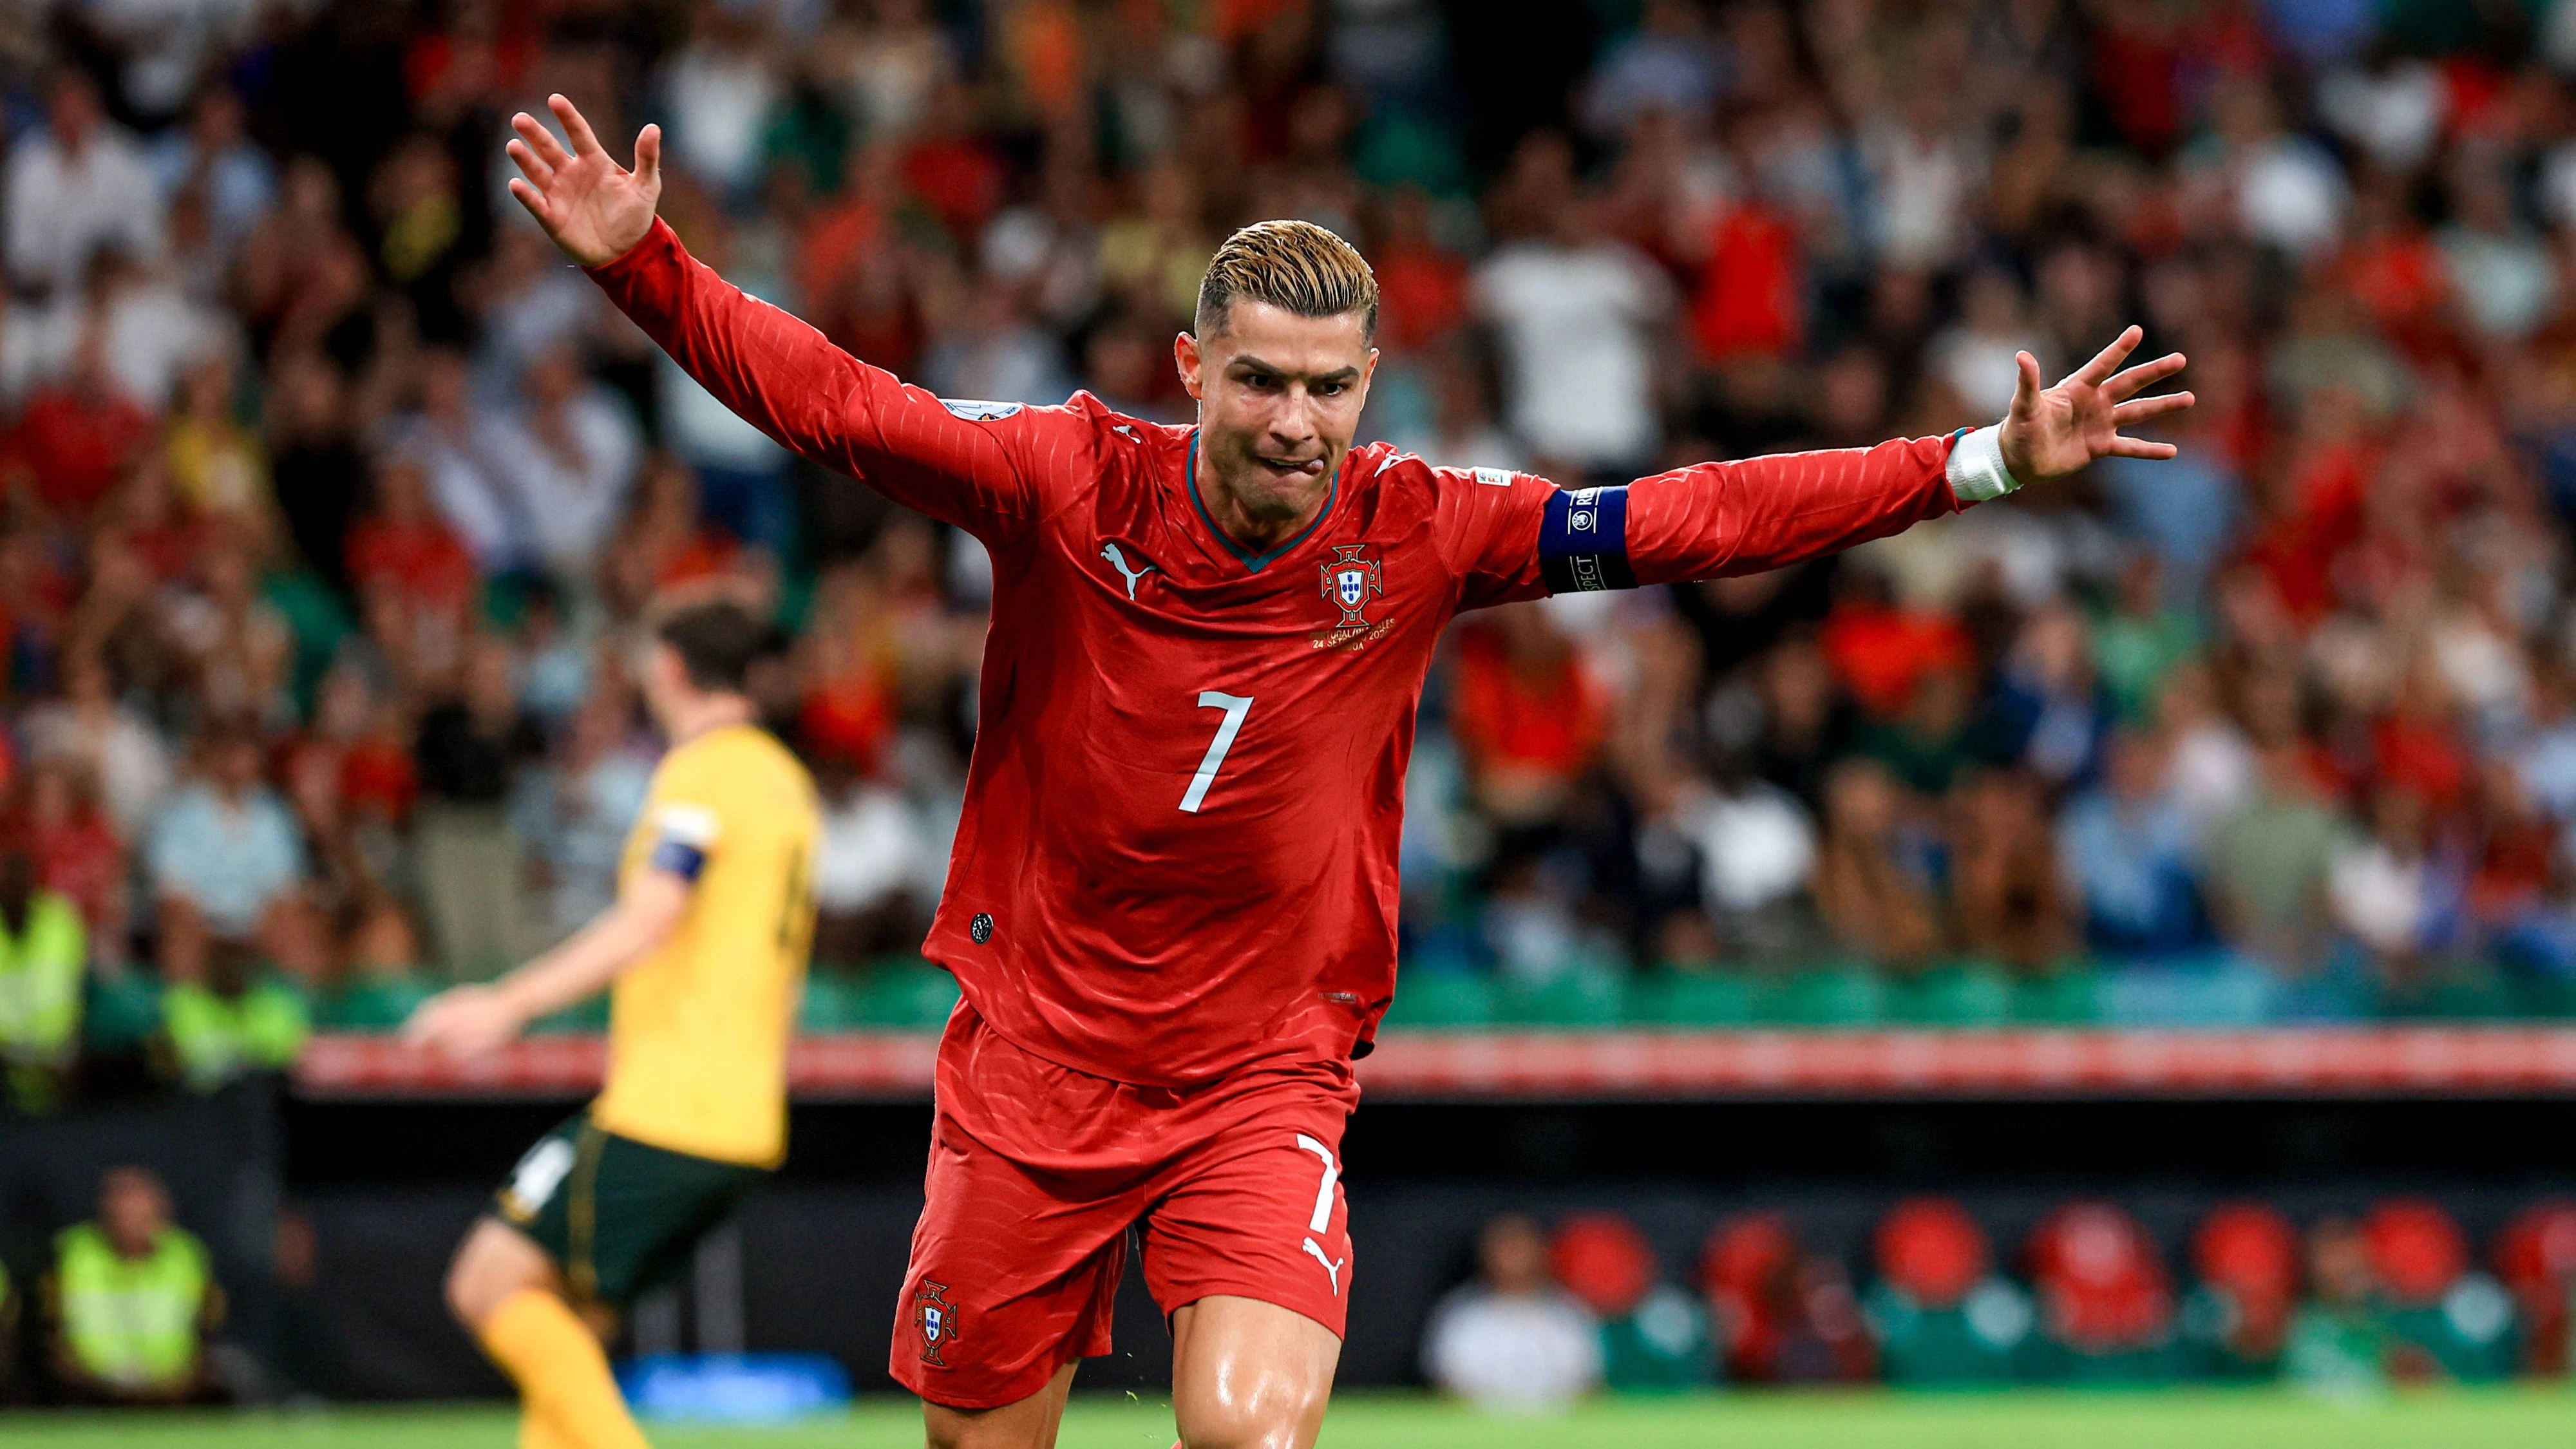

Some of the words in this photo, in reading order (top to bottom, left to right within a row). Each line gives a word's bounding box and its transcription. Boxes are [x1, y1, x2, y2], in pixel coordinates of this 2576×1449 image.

[1313, 639, 1323, 649] 24
[1178, 690, 1255, 813] 7
[1296, 1133, 1338, 1235] 7
